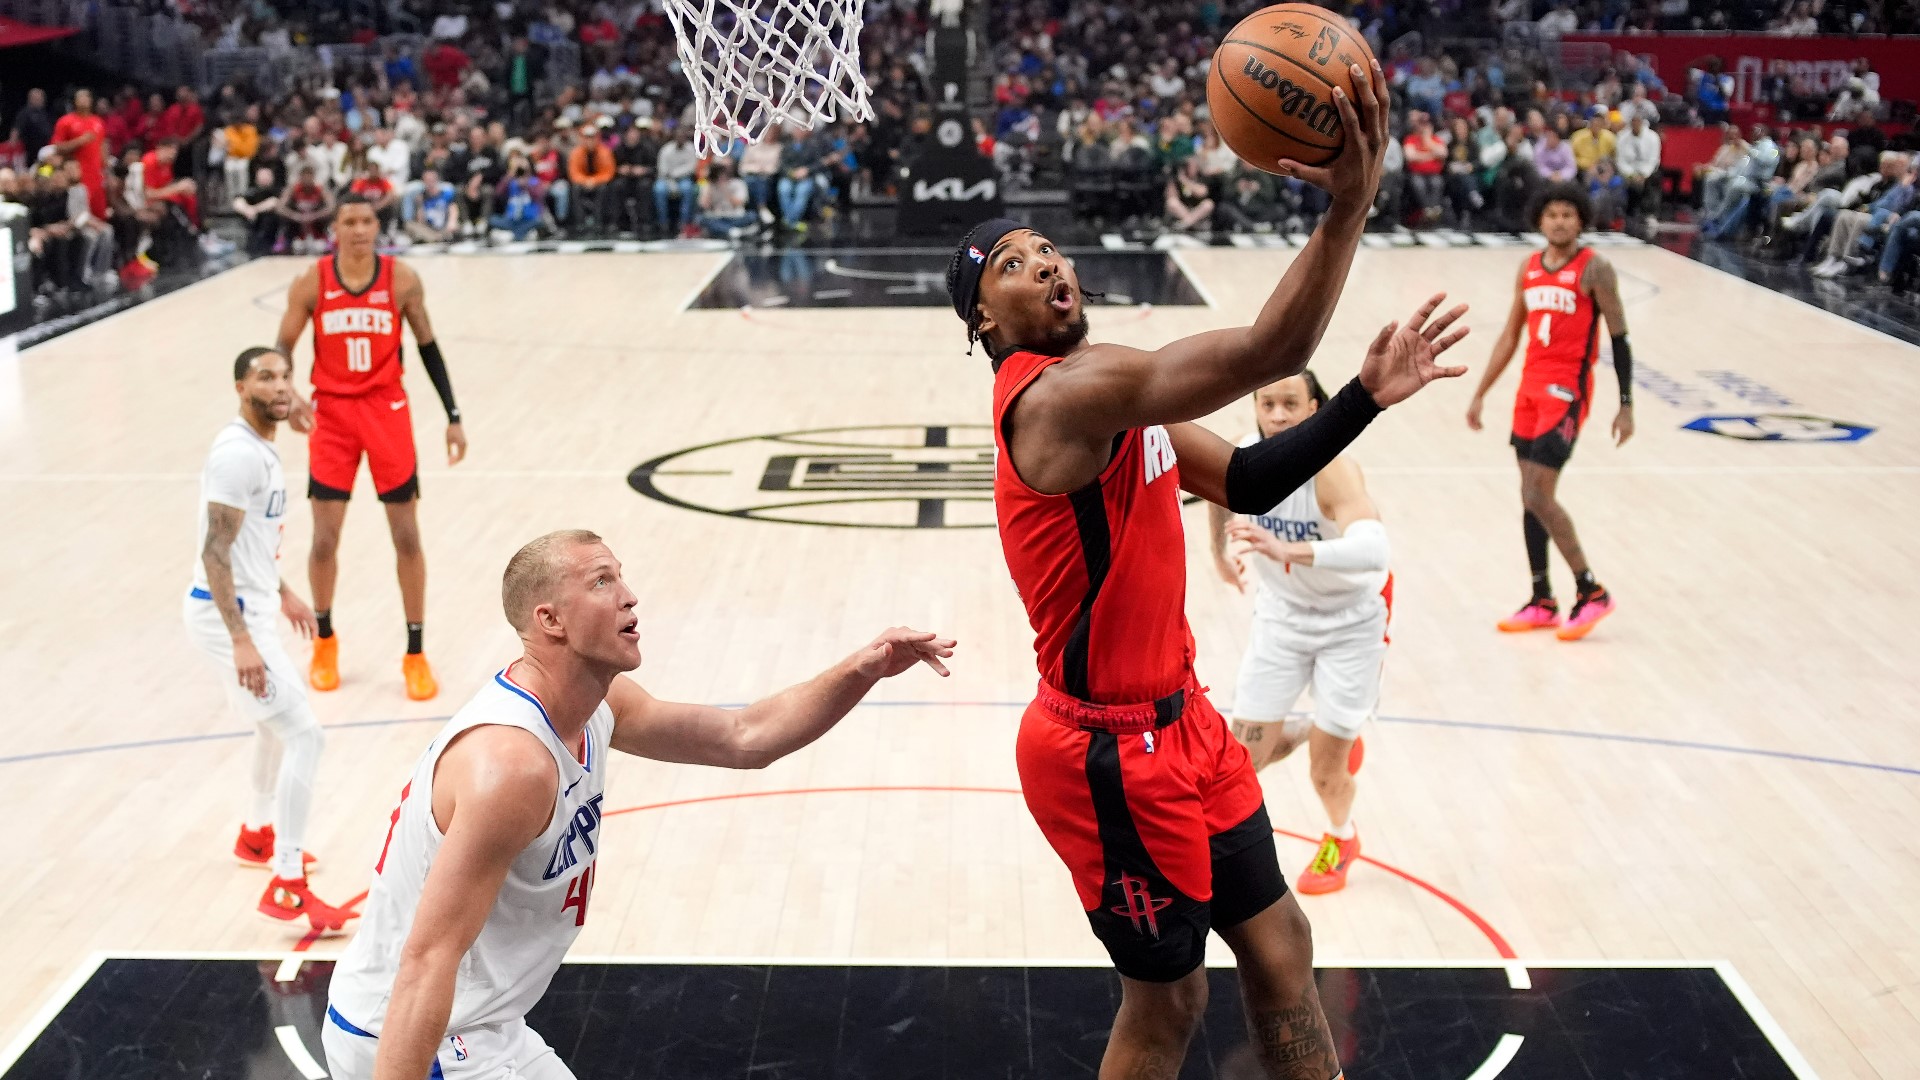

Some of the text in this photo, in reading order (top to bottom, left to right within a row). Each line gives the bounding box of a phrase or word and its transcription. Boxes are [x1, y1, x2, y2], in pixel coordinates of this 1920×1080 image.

[1243, 54, 1342, 139] Wilson
[1523, 284, 1577, 315] ROCKETS
[321, 307, 394, 335] ROCKETS
[1537, 312, 1552, 348] 4
[344, 336, 372, 373] 10
